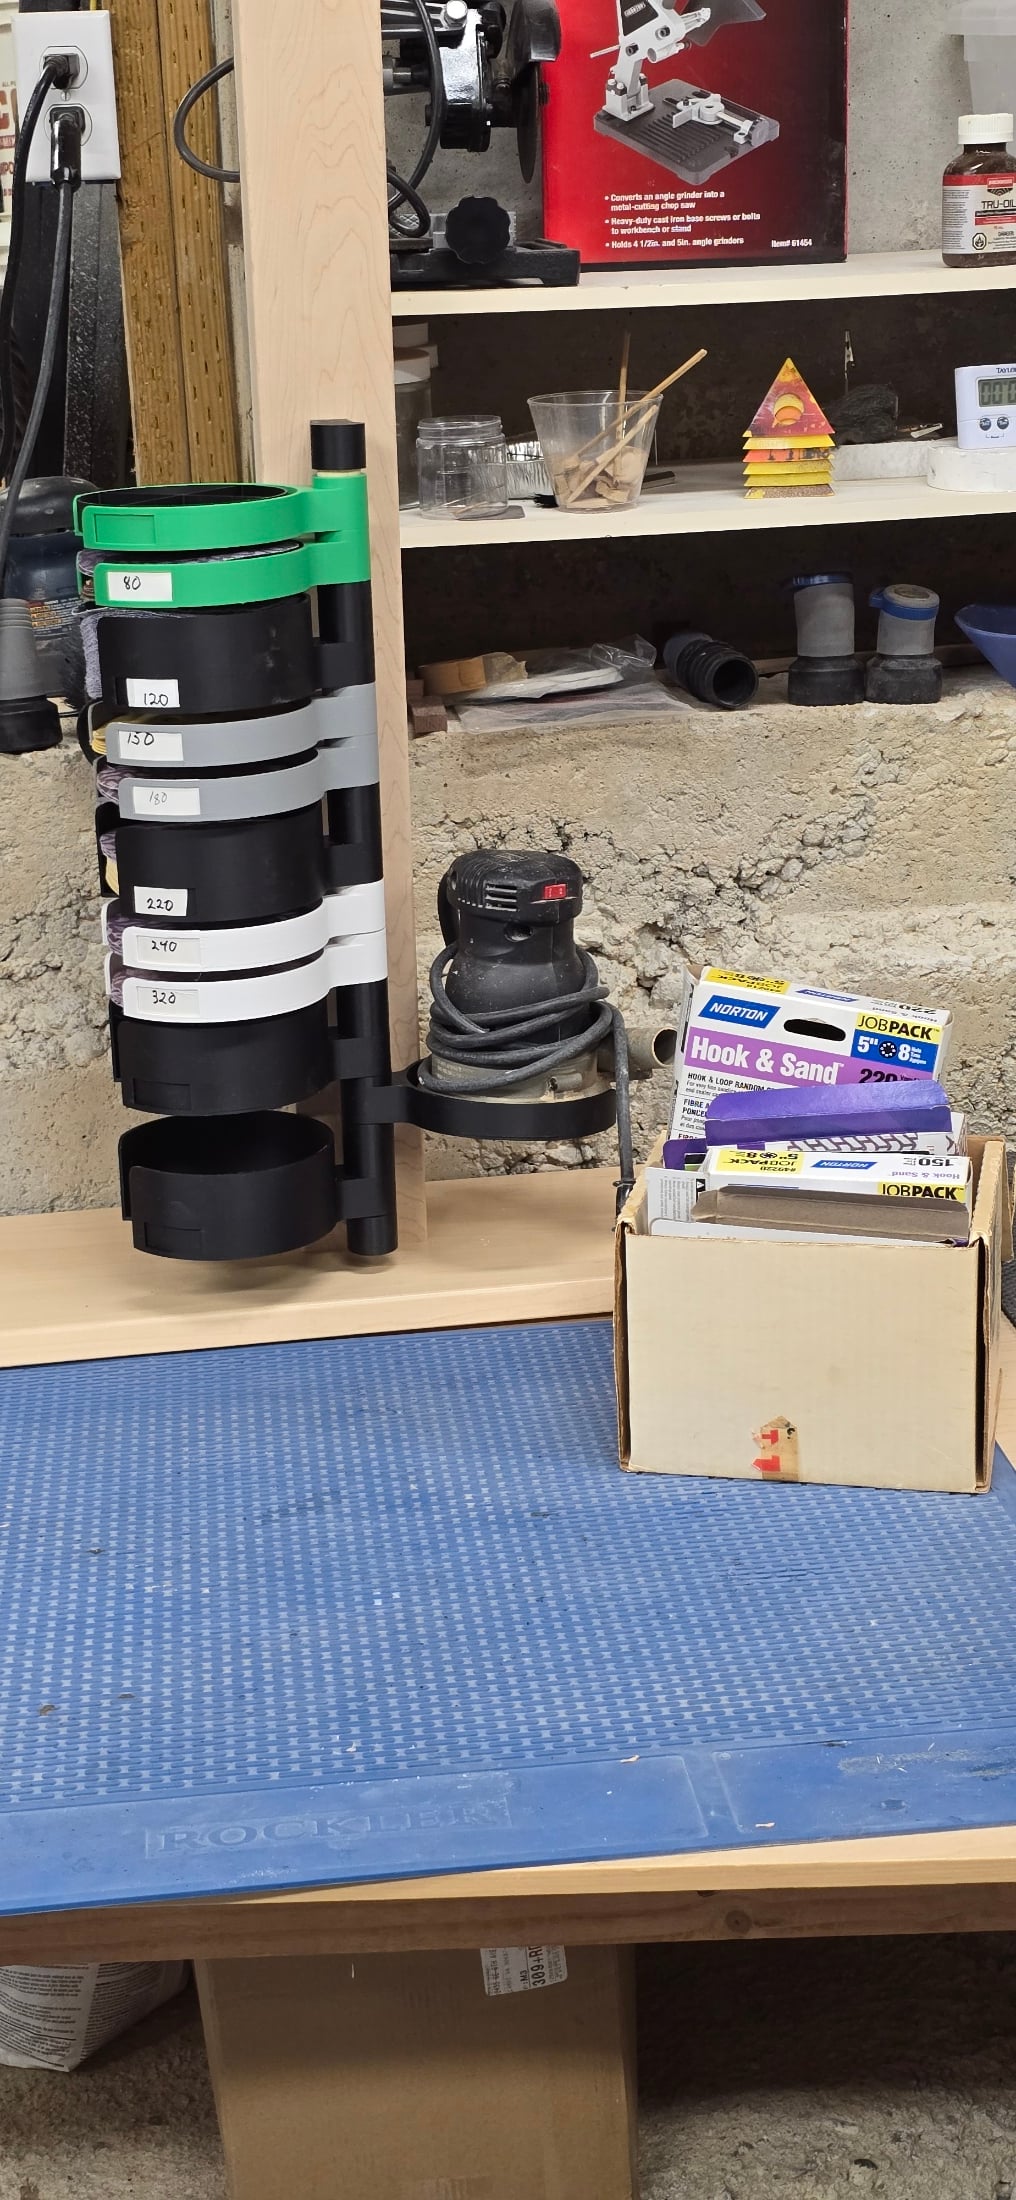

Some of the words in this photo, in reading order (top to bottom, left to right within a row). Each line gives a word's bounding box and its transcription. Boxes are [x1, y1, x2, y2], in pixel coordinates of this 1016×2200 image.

[610, 193, 642, 201] Converts
[655, 192, 675, 202] angle
[676, 191, 702, 201] grinder
[610, 202, 660, 212] metal-cutting
[661, 202, 679, 211] chop
[981, 199, 1016, 209] TRU-OIL
[611, 216, 652, 226] Heavy-duty
[670, 215, 684, 223] iron
[705, 214, 731, 222] screws
[741, 212, 760, 221] bolts
[620, 226, 660, 234] workbench
[671, 224, 692, 233] stand
[611, 240, 632, 249] Holds
[633, 240, 639, 248] 4
[661, 239, 675, 247] and
[692, 238, 712, 247] angle
[713, 236, 744, 247] grinders
[771, 239, 790, 248] Item#
[791, 238, 812, 247] 61454
[123, 575, 141, 590] 80
[143, 693, 169, 706] 120
[127, 731, 155, 746] 150
[149, 791, 168, 805] 180
[146, 898, 174, 911] 220
[151, 939, 177, 952] 240
[152, 990, 177, 1004] 320
[709, 1002, 769, 1022] NORTON
[857, 1036, 879, 1053] 5"
[898, 1043, 911, 1061] 8
[690, 1035, 751, 1069] Hook
[755, 1048, 775, 1073] &
[780, 1052, 839, 1085] Sand
[688, 1072, 706, 1082] HOOK
[709, 1075, 714, 1083] &
[715, 1077, 734, 1087] LOOP
[859, 1068, 898, 1083] 220
[683, 1098, 704, 1108] FIBRE
[918, 1158, 955, 1167] 150
[934, 1172, 960, 1180] Hook
[160, 1802, 497, 1851] ROCKLER
